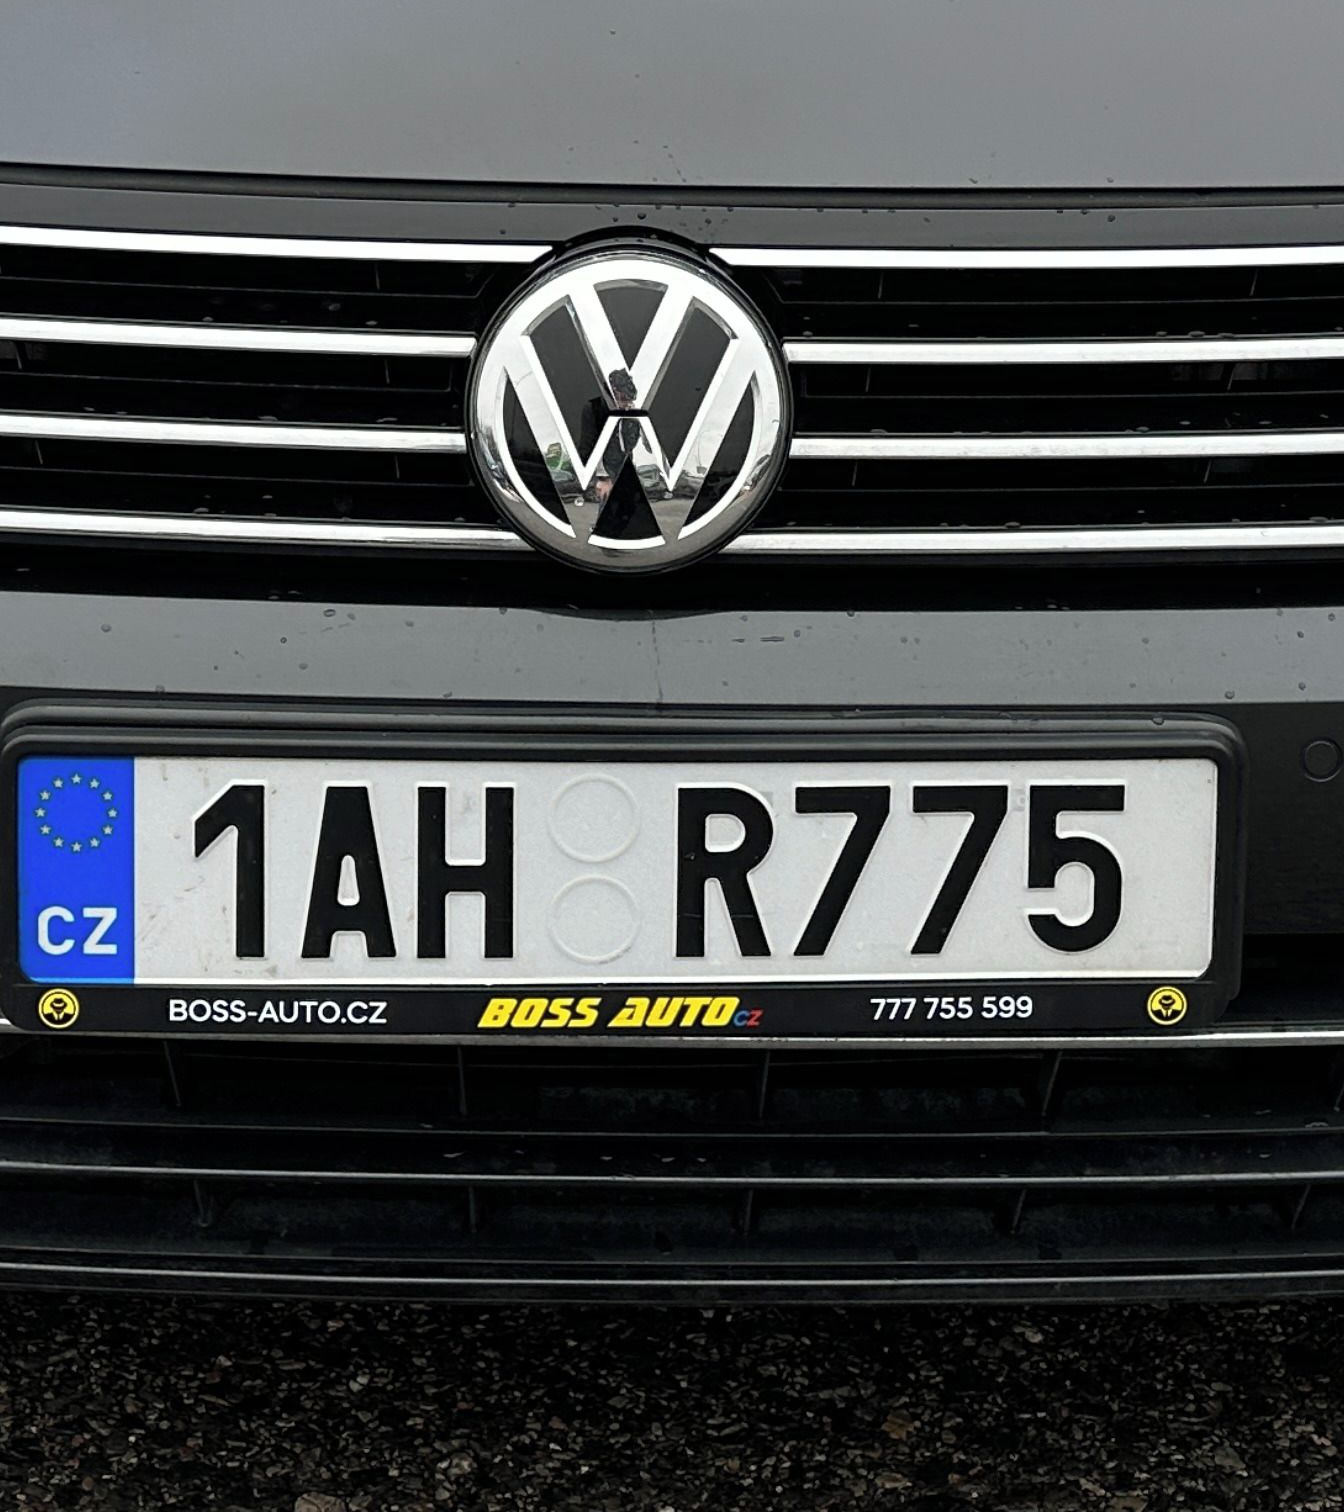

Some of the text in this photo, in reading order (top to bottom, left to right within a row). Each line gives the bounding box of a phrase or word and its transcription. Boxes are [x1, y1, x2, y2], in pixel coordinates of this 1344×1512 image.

[194, 784, 1125, 959] 1AH R775
[37, 906, 118, 955] CZ
[168, 999, 388, 1024] BOSS-AUTO.CZ
[477, 997, 602, 1028] BOSS
[607, 996, 740, 1028] AUTO
[870, 995, 1034, 1021] 777 755 599
